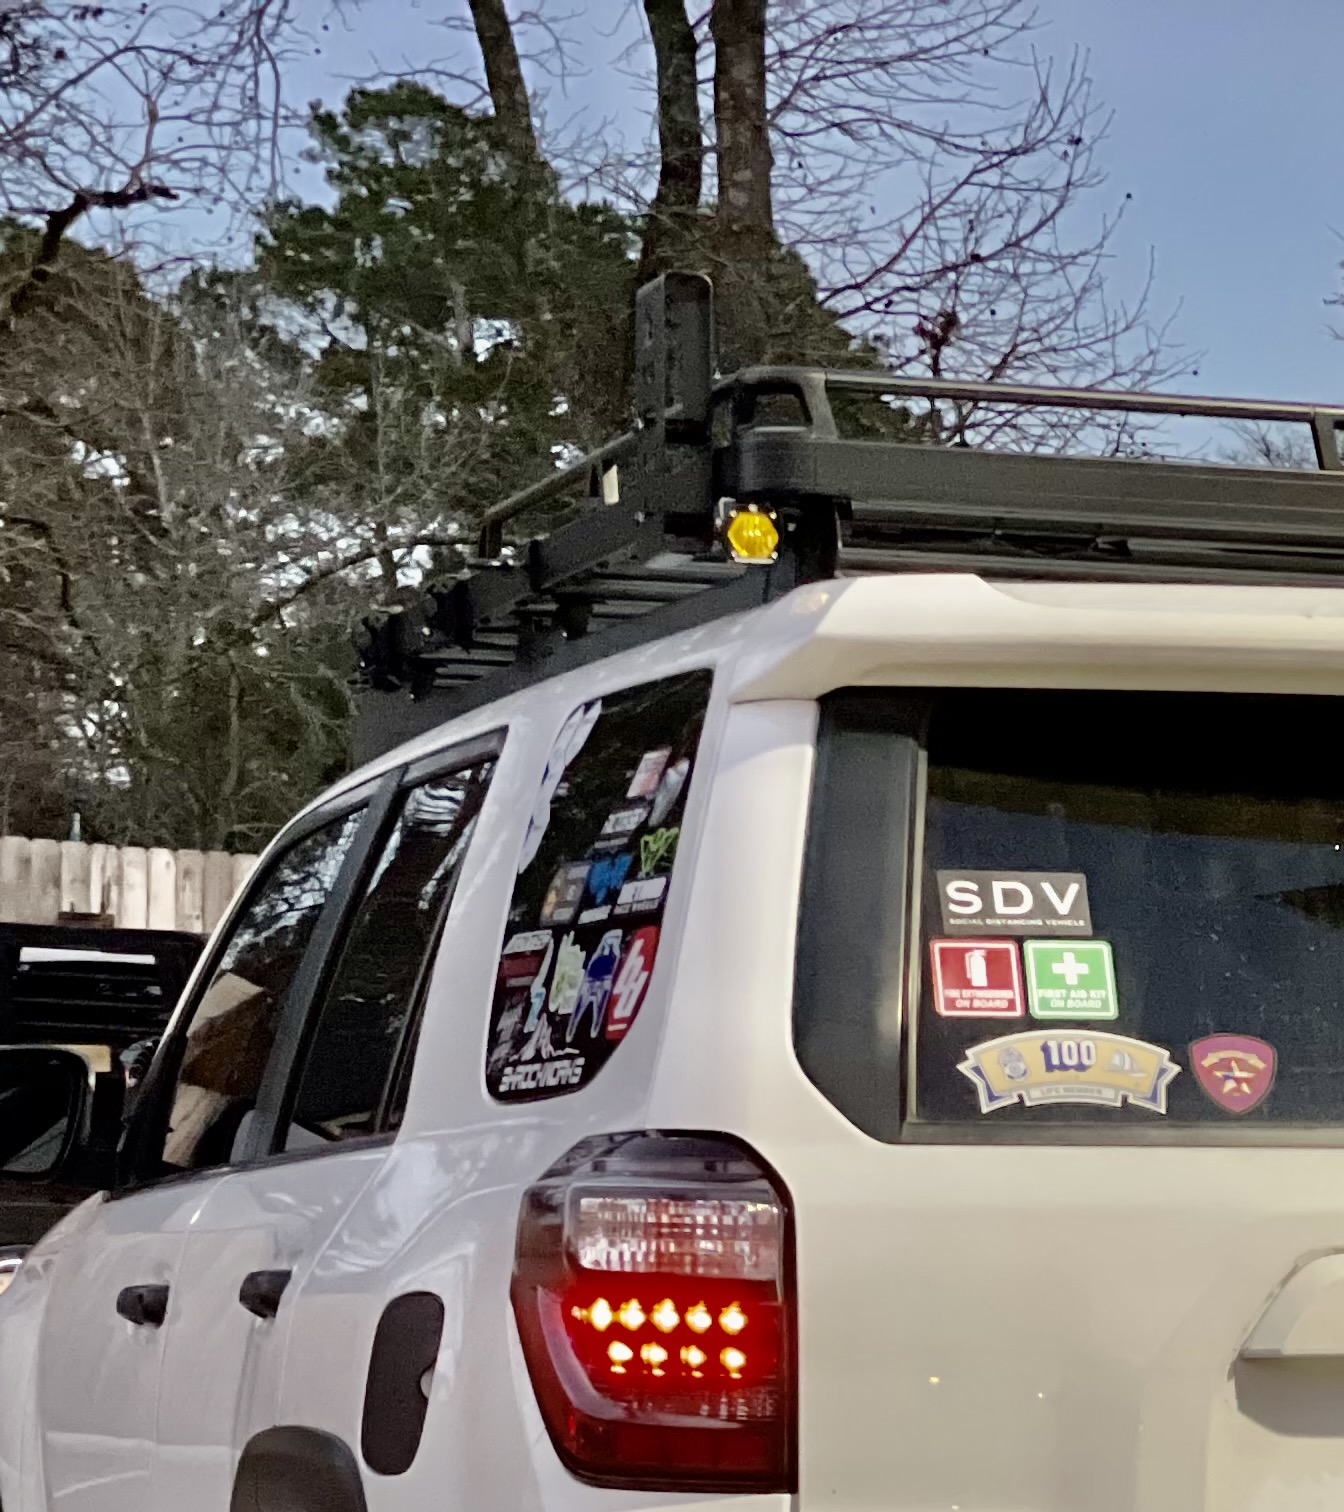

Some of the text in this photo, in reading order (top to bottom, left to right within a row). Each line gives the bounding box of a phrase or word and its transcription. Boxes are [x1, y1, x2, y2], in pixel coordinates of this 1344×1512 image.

[945, 880, 1080, 916] SDV
[1045, 919, 1085, 927] VEHICLE
[1069, 989, 1087, 998] AID
[955, 999, 1009, 1009] ON BOARD
[1050, 999, 1102, 1008] ON BOARD
[1043, 1040, 1097, 1069] 100
